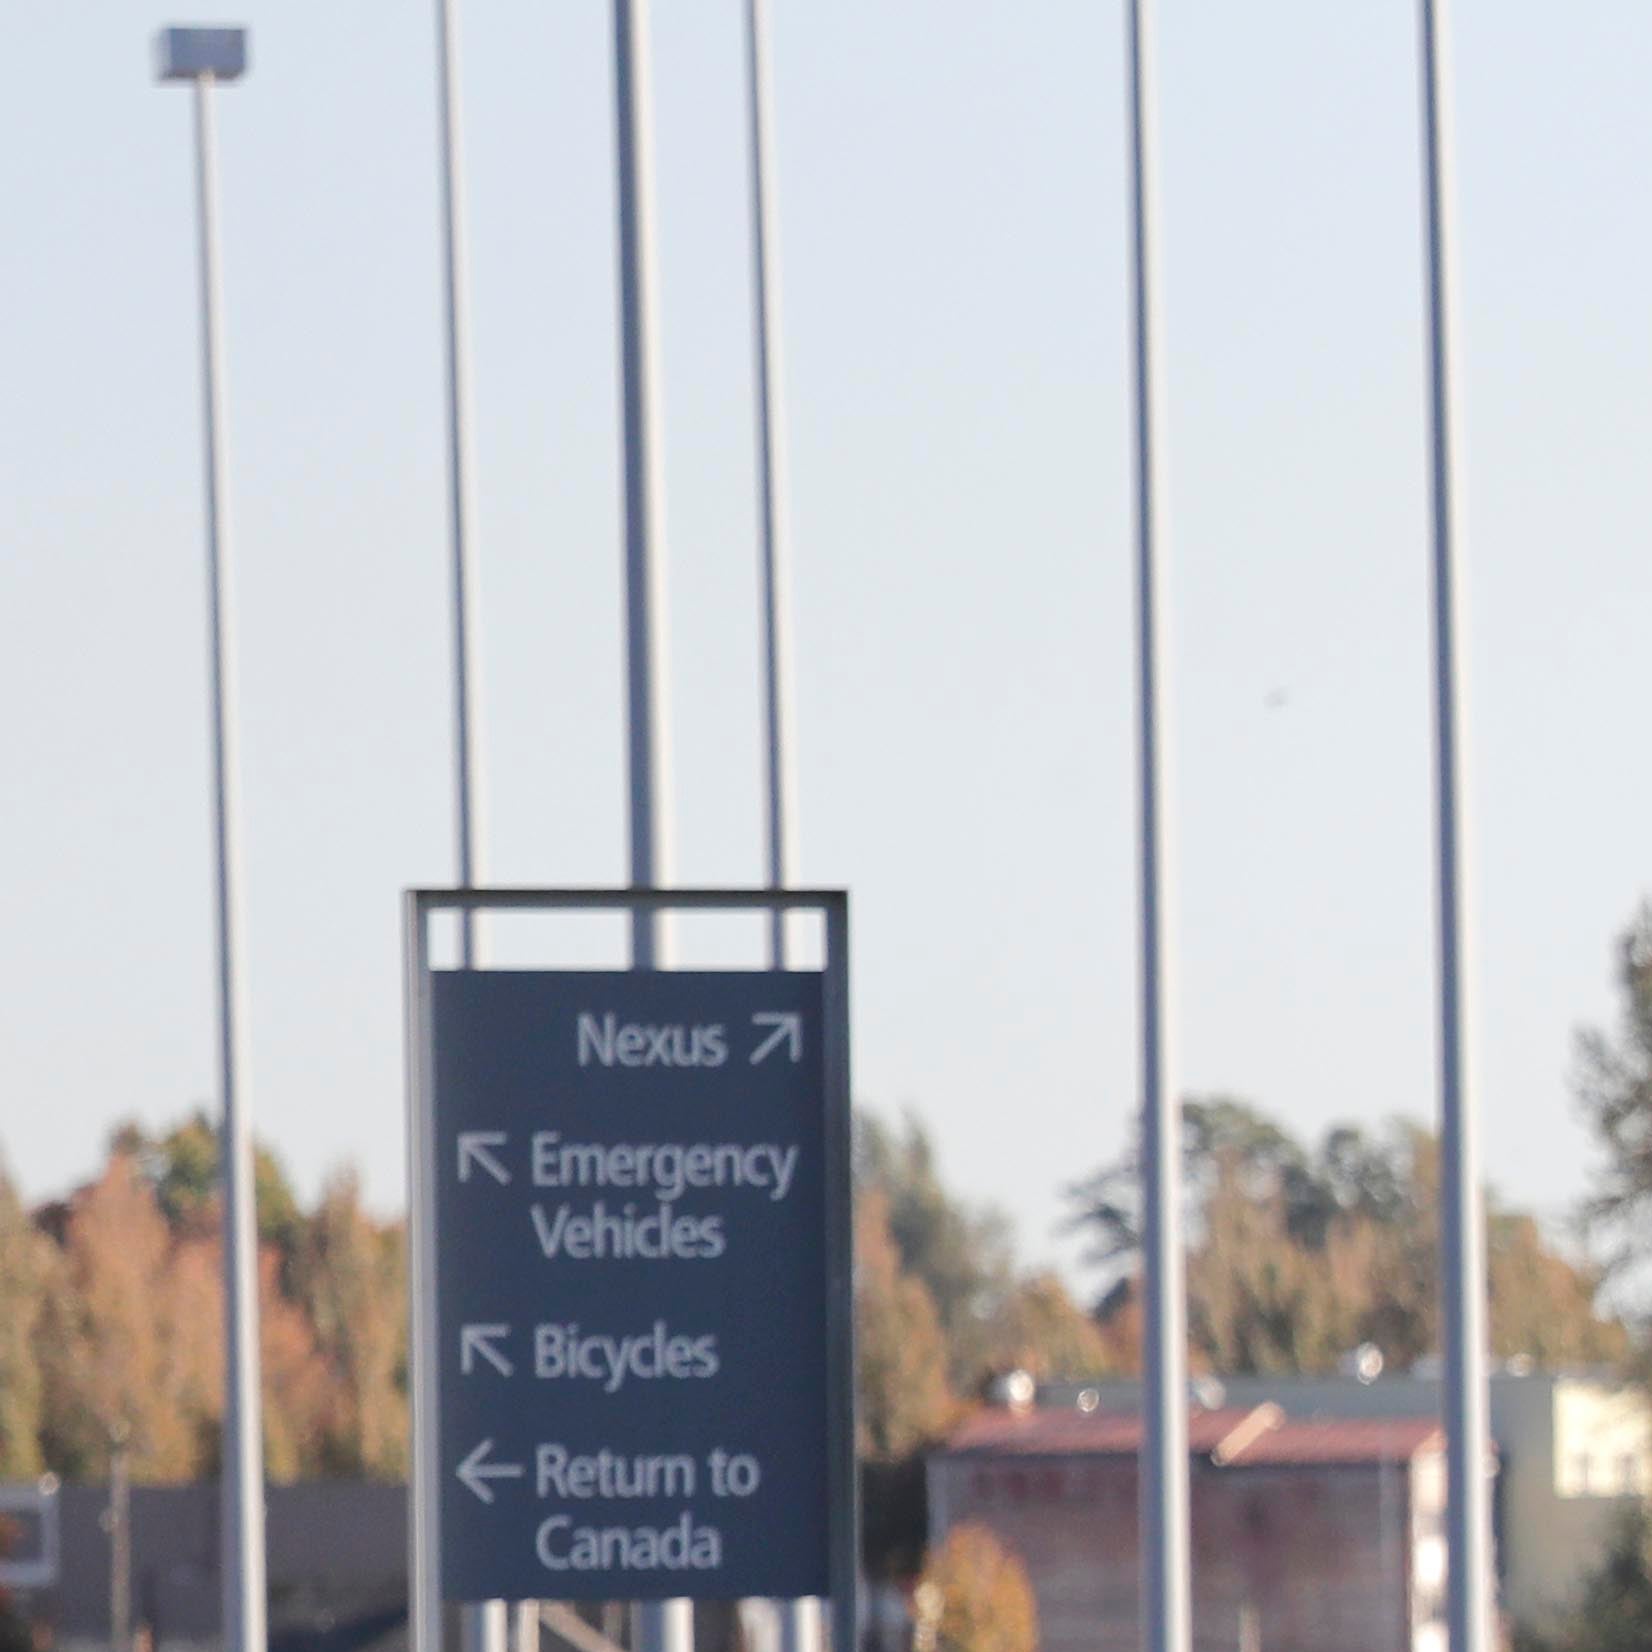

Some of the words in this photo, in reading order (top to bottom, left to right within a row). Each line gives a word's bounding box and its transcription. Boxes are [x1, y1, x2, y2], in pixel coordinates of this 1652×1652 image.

[577, 1011, 728, 1068] Nexus
[530, 1130, 798, 1202] Emergency
[530, 1202, 726, 1260] Vehicles
[534, 1320, 720, 1393] Bicycles
[535, 1442, 696, 1499] Return
[708, 1447, 761, 1498] to
[535, 1510, 722, 1571] Canada
